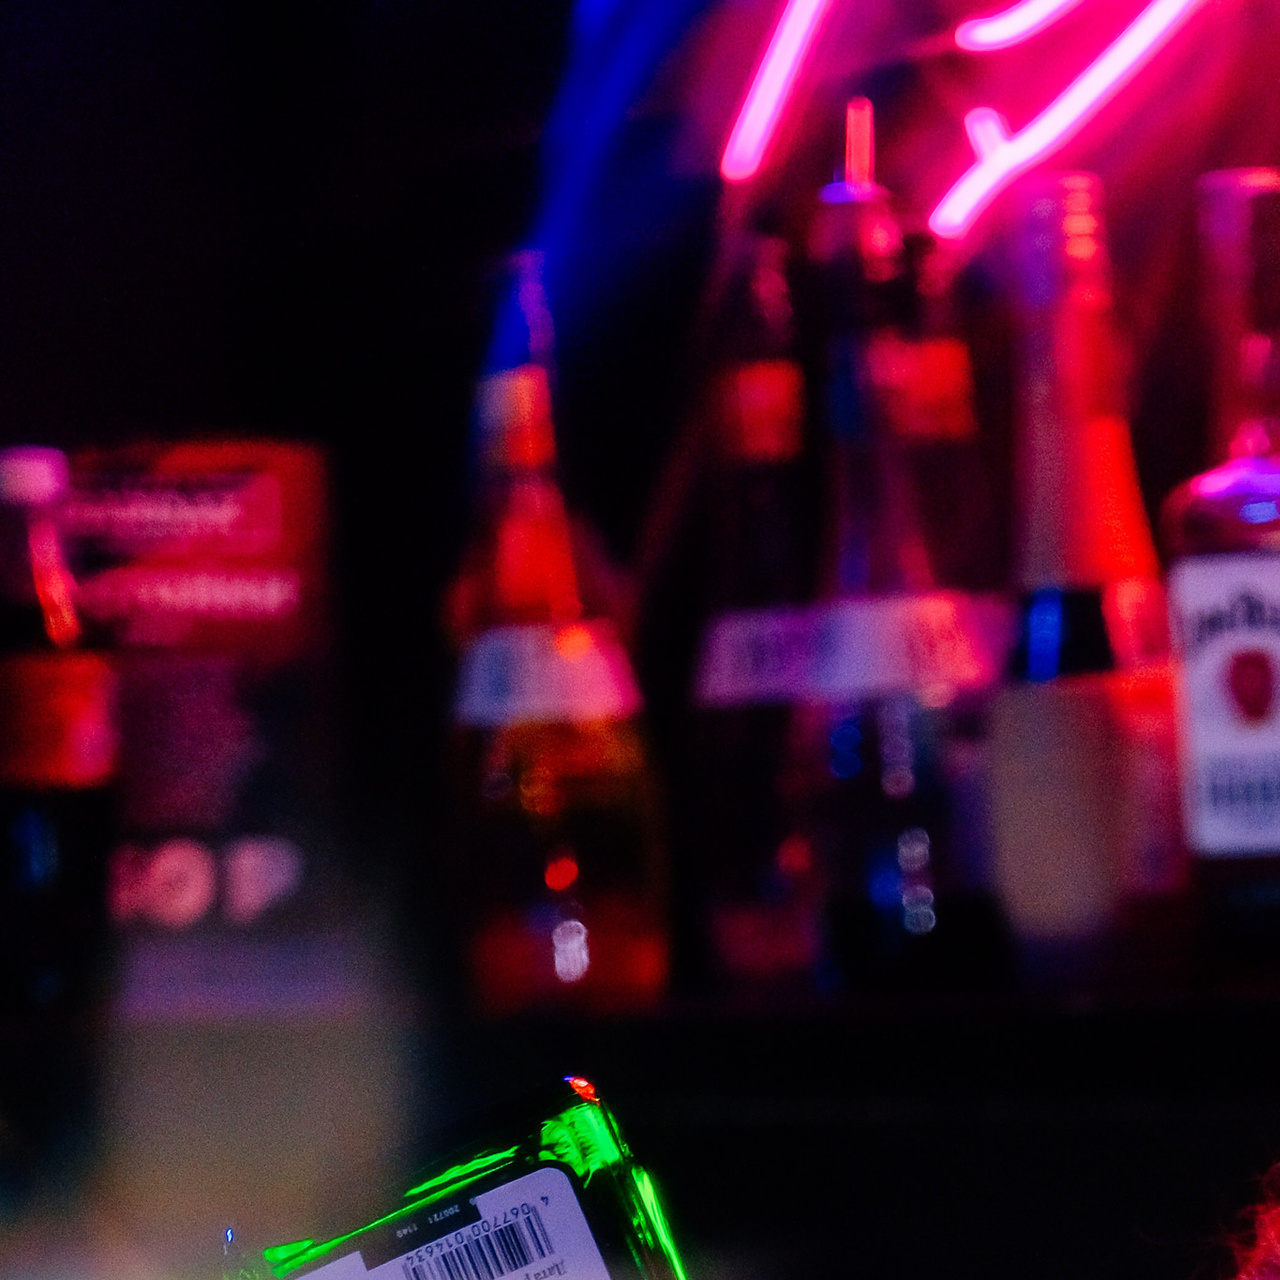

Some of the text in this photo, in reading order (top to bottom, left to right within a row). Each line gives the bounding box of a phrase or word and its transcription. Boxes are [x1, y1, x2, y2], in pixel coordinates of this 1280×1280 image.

[403, 1193, 550, 1269] 4 067700 014634
